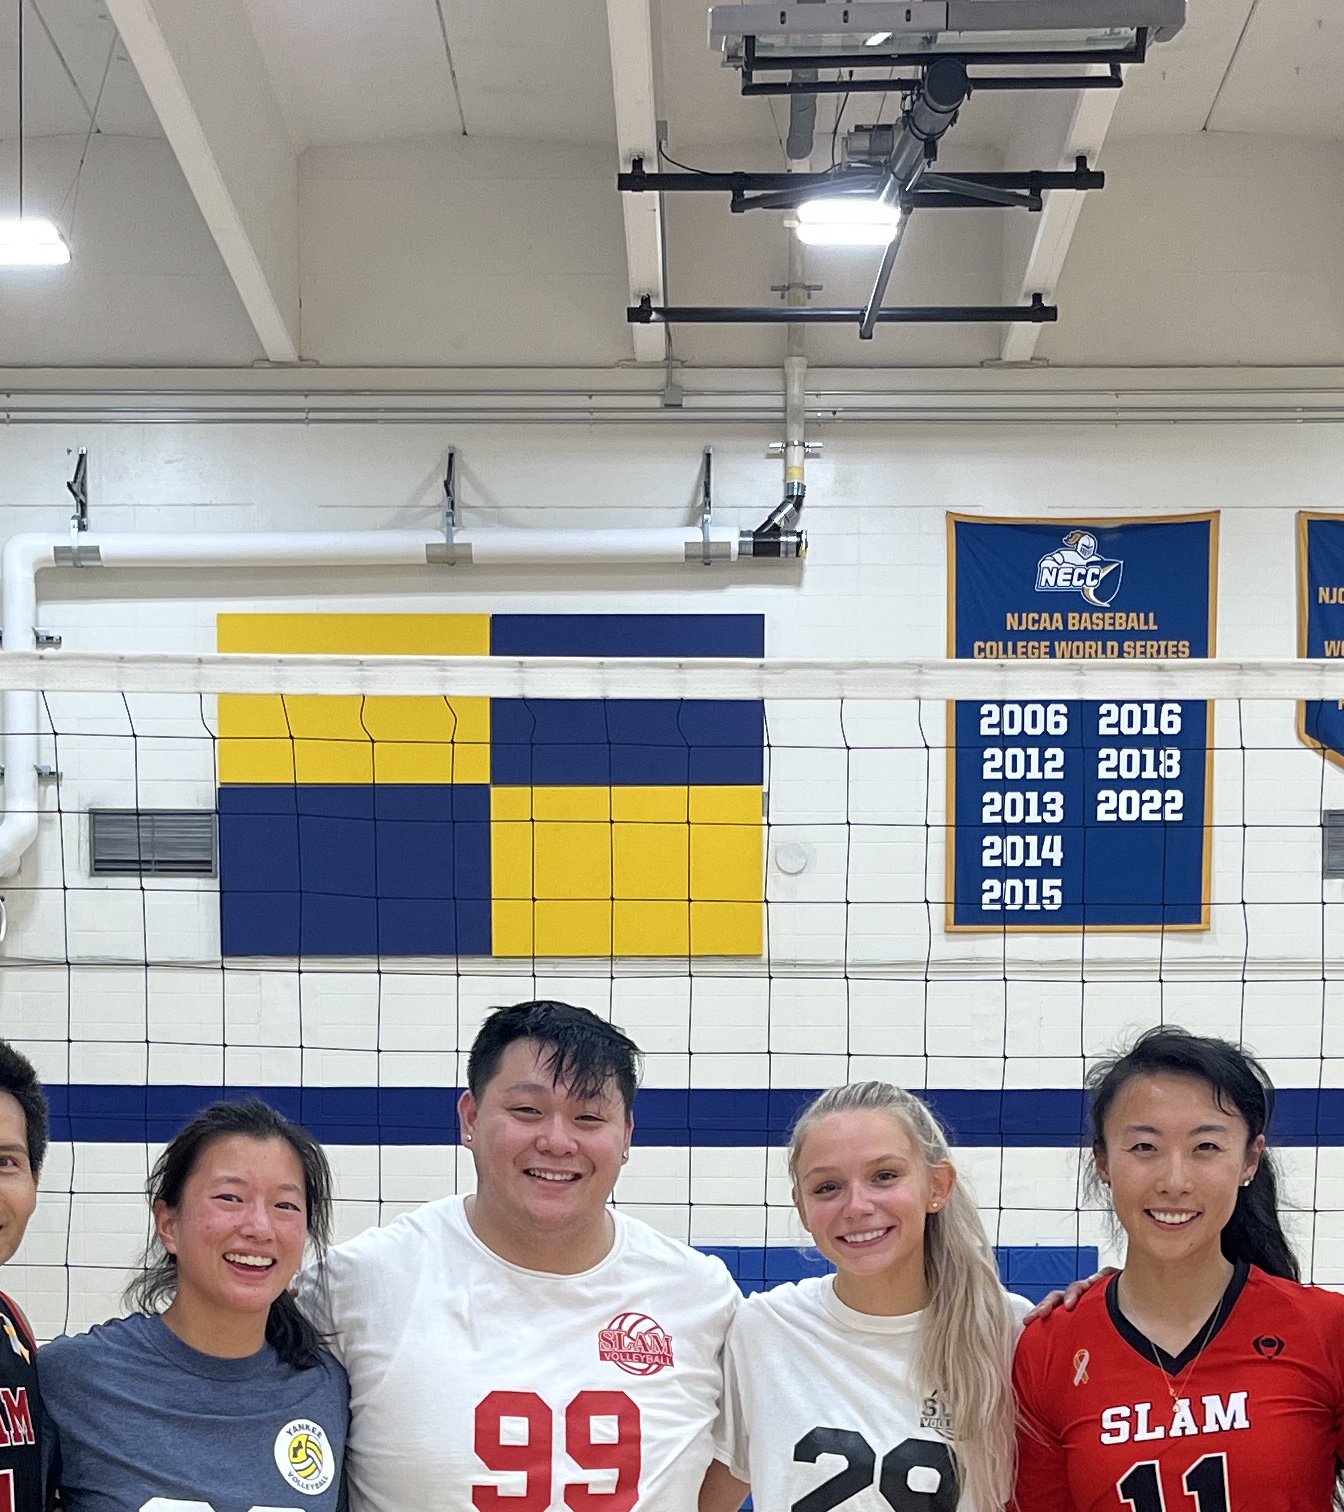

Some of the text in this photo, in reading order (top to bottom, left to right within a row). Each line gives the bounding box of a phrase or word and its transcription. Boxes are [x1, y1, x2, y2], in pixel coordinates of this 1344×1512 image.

[1040, 567, 1100, 587] NECC
[1006, 612, 1158, 631] NJCAA BASEBALL
[973, 640, 1190, 659] COLLEGE WORLD SERIES
[979, 703, 1068, 736] 2006
[1098, 702, 1182, 736] 2016
[982, 748, 1065, 780] 2012
[1097, 747, 1181, 780] 2018
[981, 791, 1064, 824] 2013
[1096, 789, 1184, 822] 2022
[981, 835, 1064, 867] 2014
[981, 878, 1063, 911] 2015
[598, 1329, 673, 1357] SLAM
[603, 1352, 671, 1366] VOLLEYBALL
[286, 1423, 323, 1439] YANKEE
[1100, 1391, 1251, 1446] SLAM
[288, 1471, 328, 1490] VOLLEYBALL
